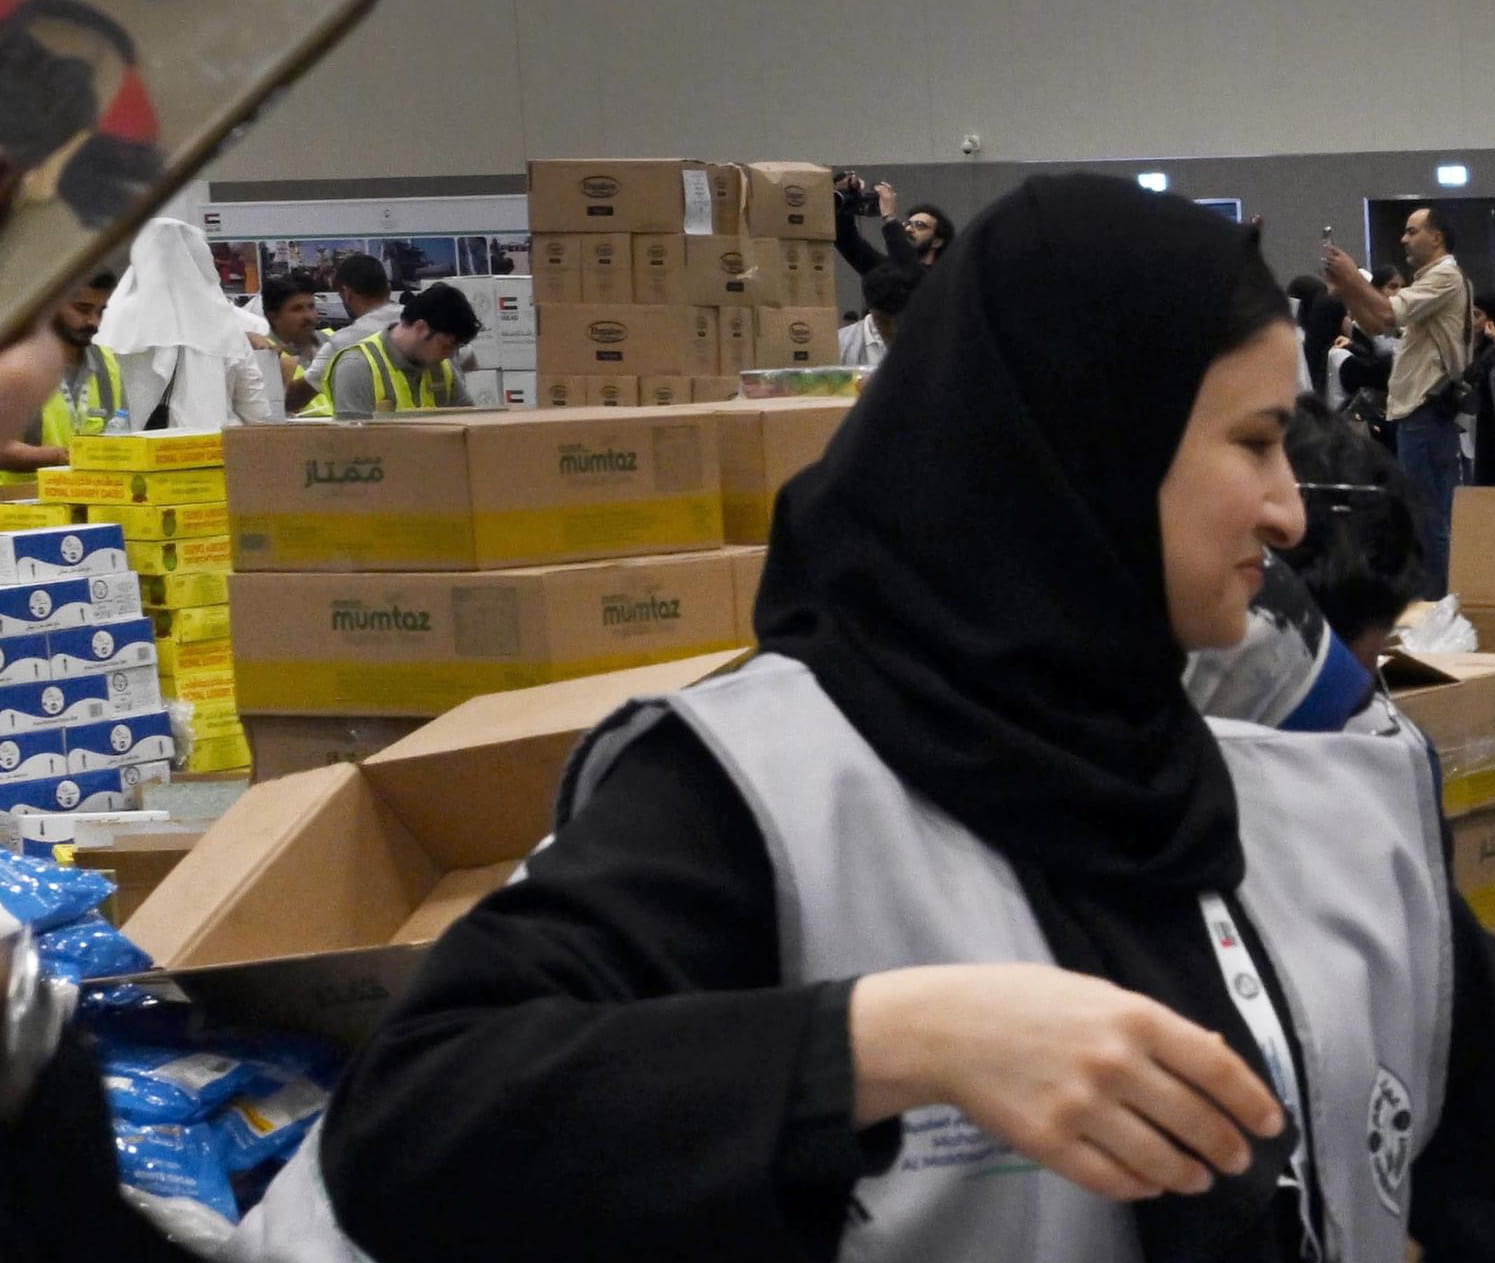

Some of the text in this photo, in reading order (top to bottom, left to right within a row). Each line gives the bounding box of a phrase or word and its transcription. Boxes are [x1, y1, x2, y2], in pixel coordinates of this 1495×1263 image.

[304, 459, 384, 488] ممتاز
[559, 447, 638, 473] mumtaz
[332, 605, 431, 631] mumtaz
[603, 595, 681, 626] mumtaz
